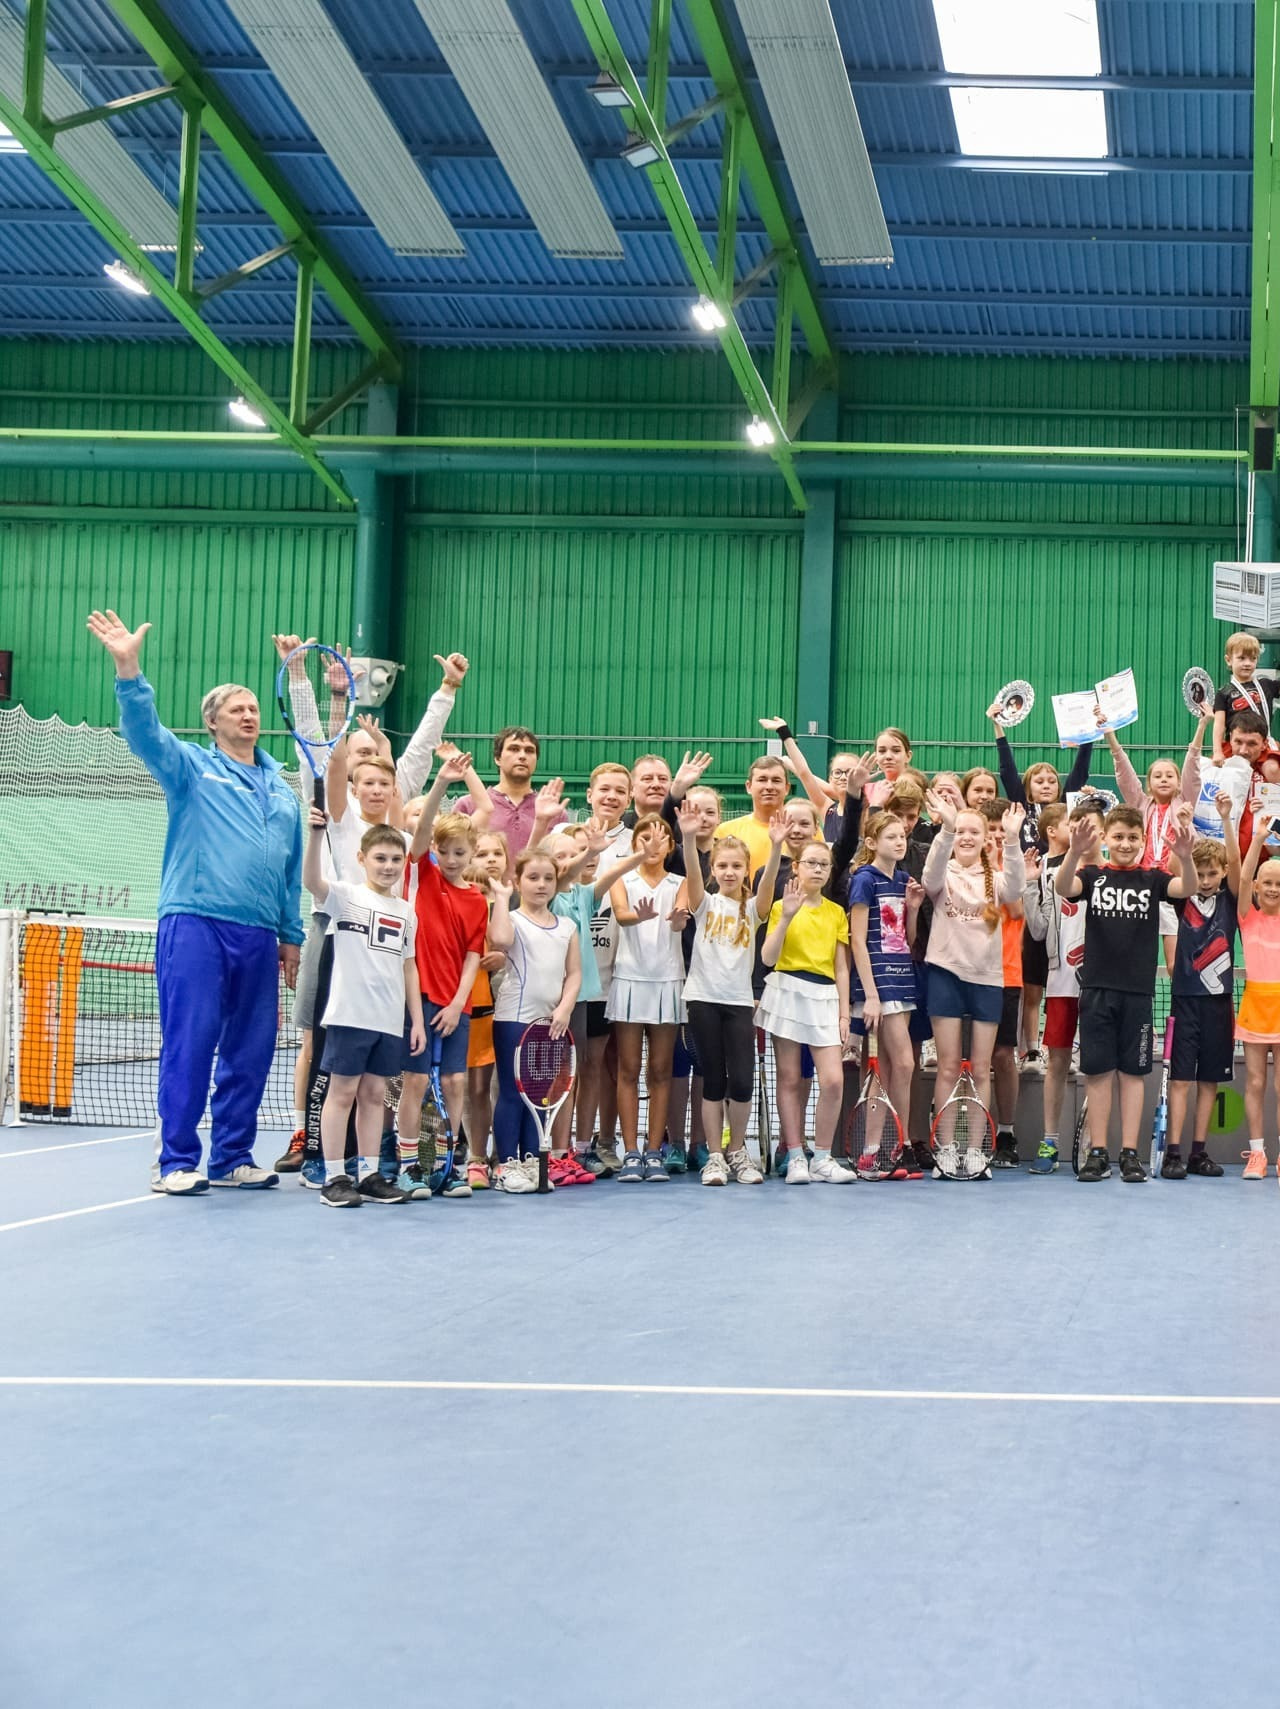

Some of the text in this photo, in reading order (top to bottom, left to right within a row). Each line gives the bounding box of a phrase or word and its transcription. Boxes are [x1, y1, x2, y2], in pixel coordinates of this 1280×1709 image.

[4, 882, 130, 908] ИМЕНИ
[1091, 886, 1151, 912] ASICS
[349, 924, 367, 932] FILA
[308, 1102, 322, 1139] STEADY
[1215, 1091, 1226, 1129] 1
[307, 1138, 320, 1151] GO
